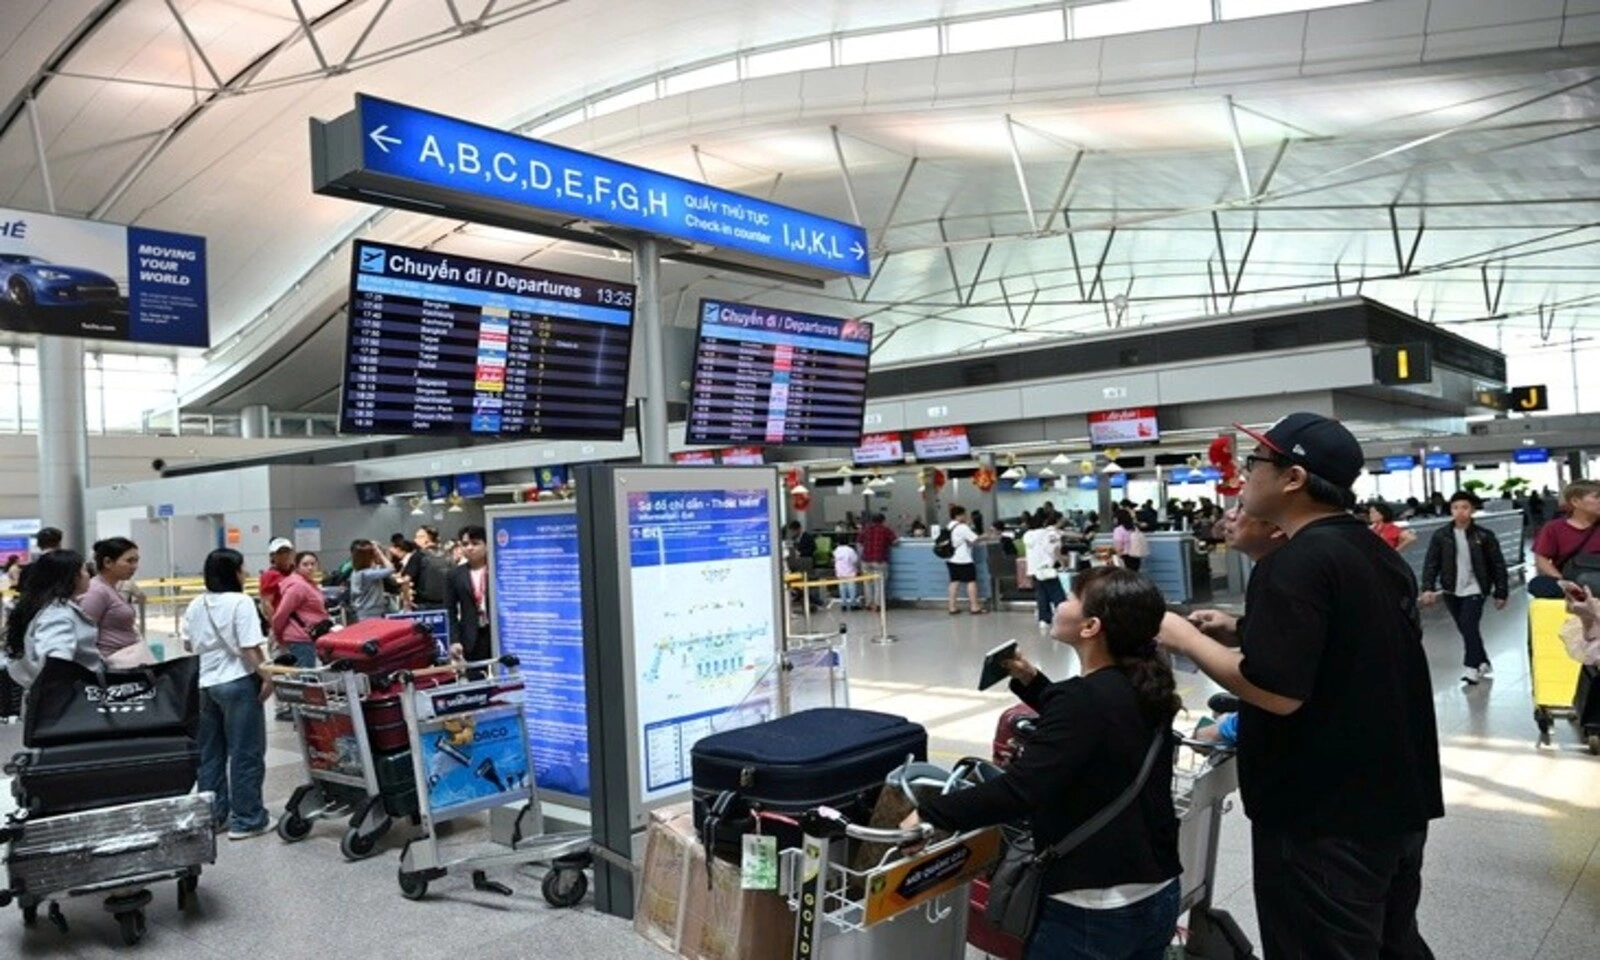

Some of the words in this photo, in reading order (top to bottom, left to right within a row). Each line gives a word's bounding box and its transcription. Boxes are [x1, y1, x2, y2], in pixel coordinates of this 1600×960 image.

[419, 135, 669, 217] A,B,C,D,E,F,G,H
[685, 214, 732, 236] Check-in
[735, 227, 772, 244] counter
[783, 223, 844, 260] I,J,K,L
[138, 244, 196, 261] MOVING
[140, 257, 179, 272] YOUR
[140, 271, 190, 286] WORLD
[389, 255, 460, 281] Chuyến
[465, 267, 481, 284] đi
[495, 271, 582, 299] Departures
[597, 288, 633, 306] 13:25
[784, 316, 838, 335] Departures
[1520, 387, 1537, 408] J
[800, 893, 814, 960] GOLD
